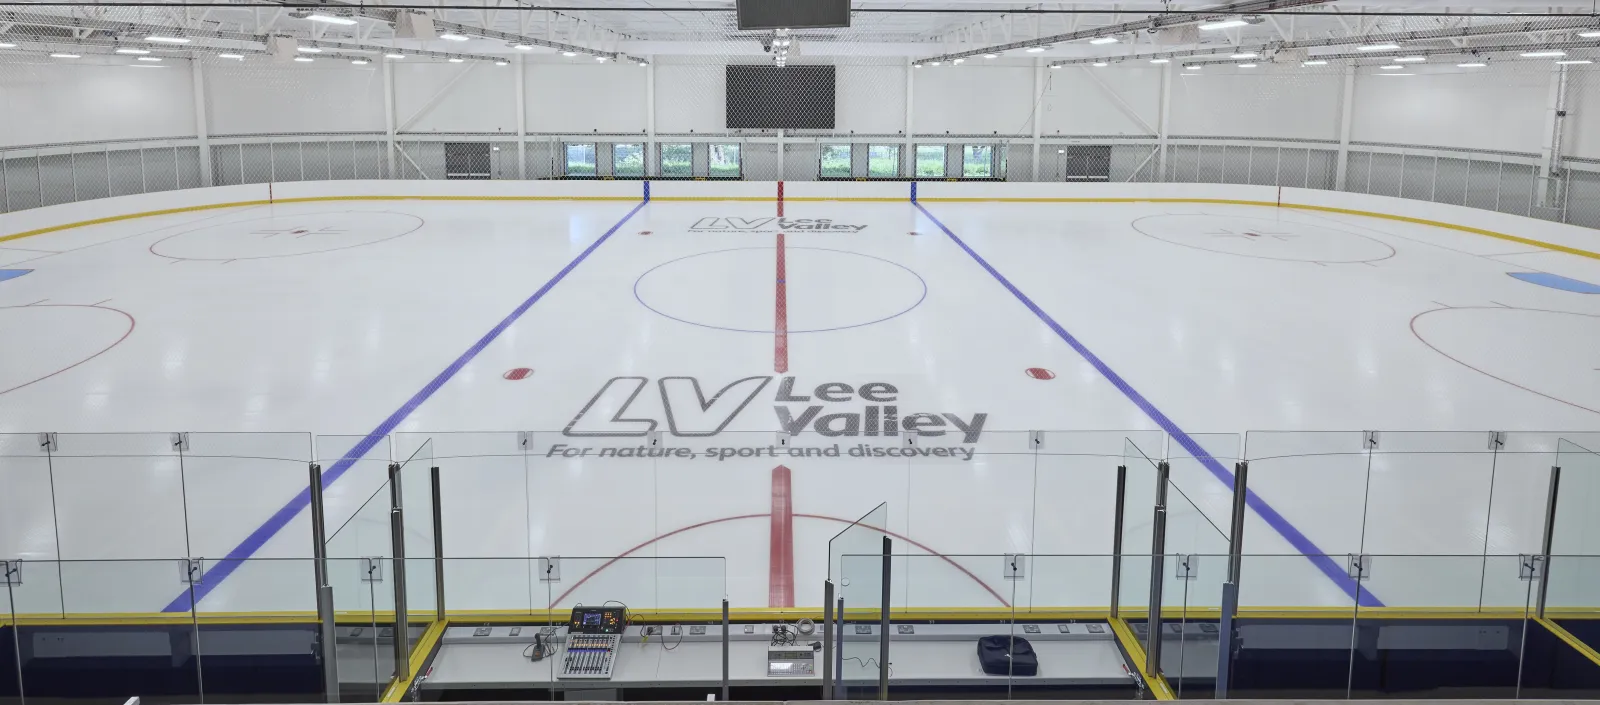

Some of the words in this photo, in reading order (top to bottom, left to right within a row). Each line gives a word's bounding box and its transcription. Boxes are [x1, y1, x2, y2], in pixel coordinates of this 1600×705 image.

[690, 217, 776, 229] LV
[774, 376, 898, 402] Lee
[562, 376, 774, 437] LV
[773, 405, 988, 443] Valley
[546, 444, 592, 457] For
[598, 445, 697, 459] nature,
[705, 445, 780, 461] sport
[787, 444, 840, 457] and
[848, 444, 975, 461] discovery
